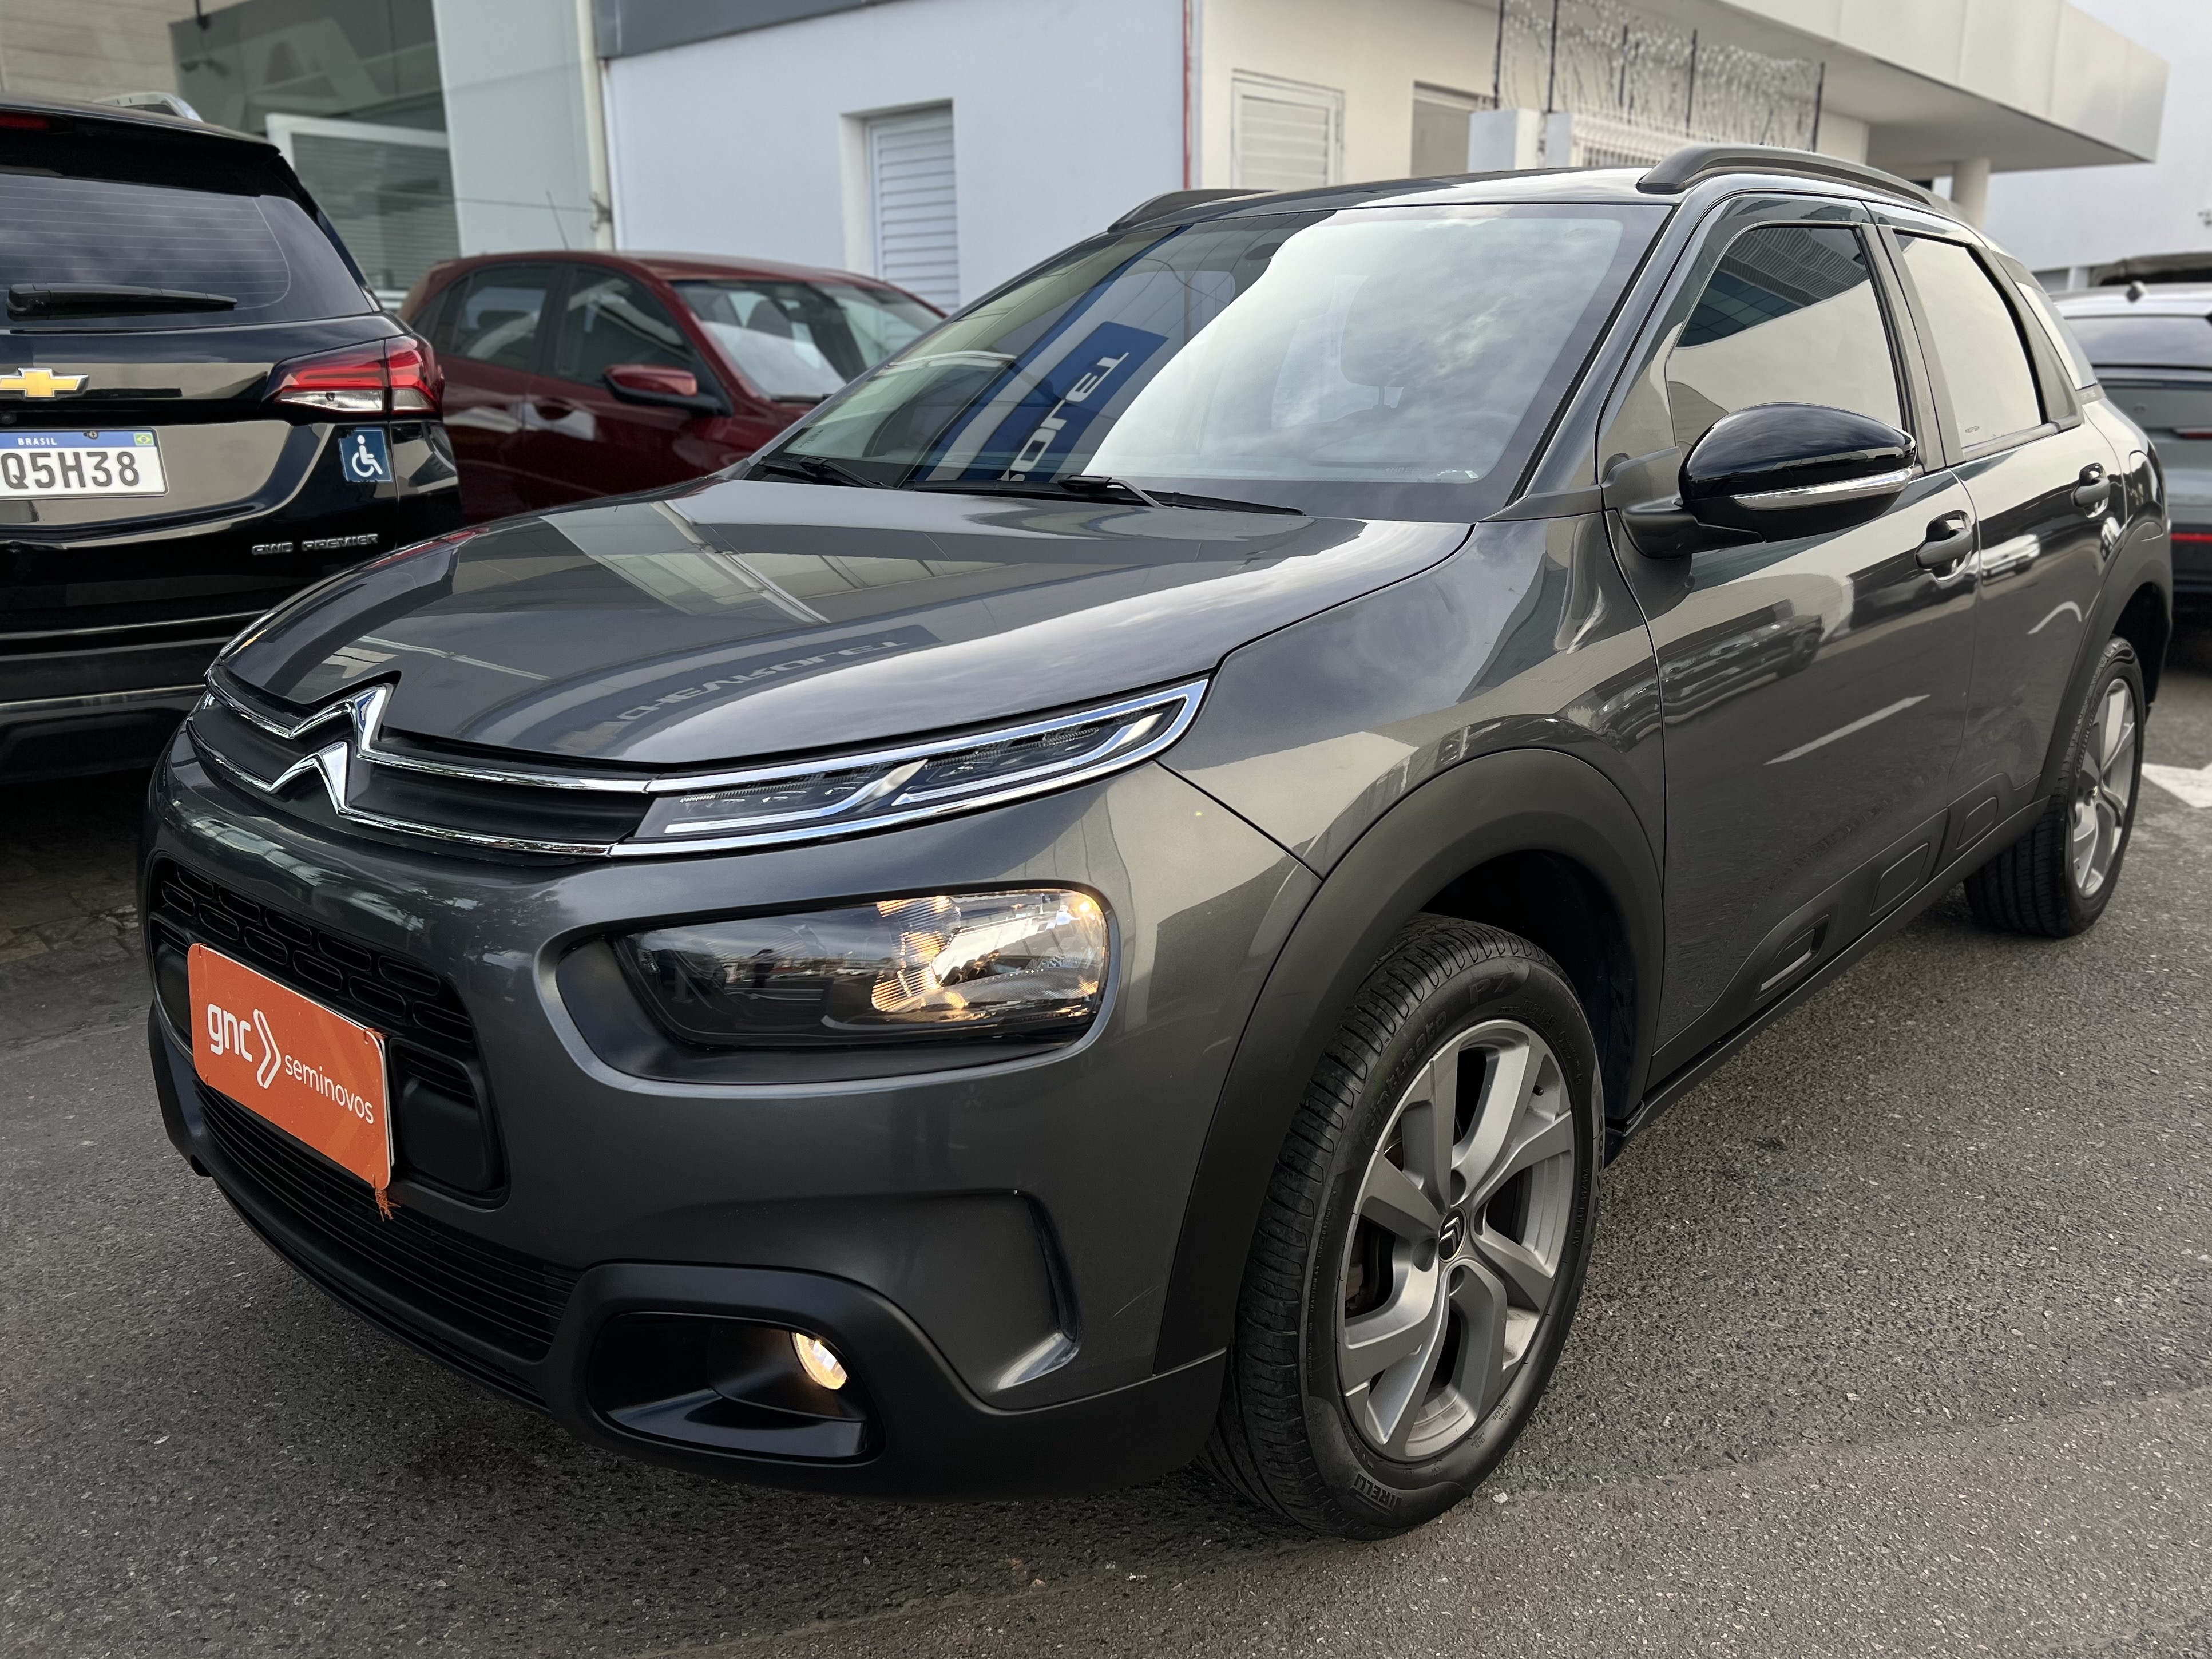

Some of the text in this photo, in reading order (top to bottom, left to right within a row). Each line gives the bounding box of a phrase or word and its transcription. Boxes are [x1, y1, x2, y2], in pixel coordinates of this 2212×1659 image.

[18, 437, 57, 446] BRASIL
[1, 451, 139, 489] Q5H38
[302, 534, 378, 551] PREMIER
[207, 1003, 374, 1125] gnc seminovos
